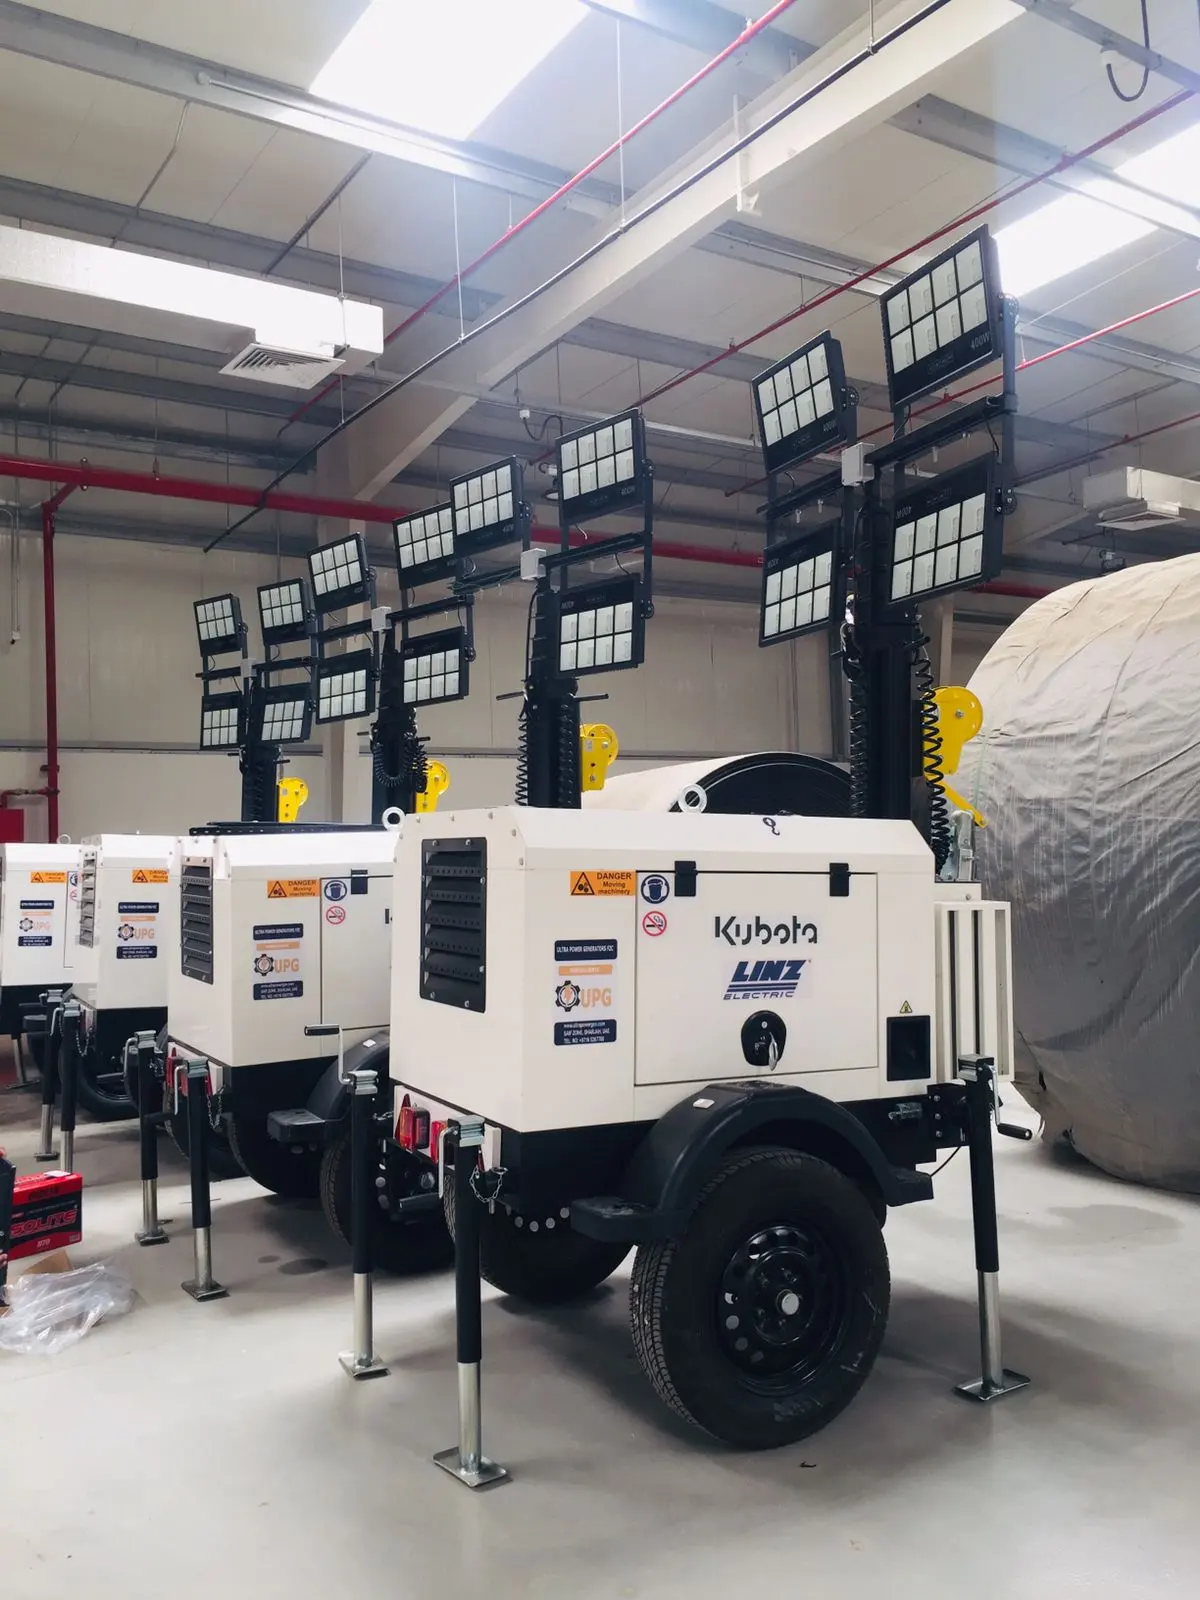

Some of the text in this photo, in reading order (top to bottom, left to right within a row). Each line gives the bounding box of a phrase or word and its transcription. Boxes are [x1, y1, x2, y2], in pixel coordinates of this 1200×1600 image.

[970, 331, 991, 350] 400W
[596, 872, 632, 880] DANGER
[602, 881, 626, 889] Moving
[134, 927, 156, 939] UPG
[714, 915, 818, 946] Kubota
[274, 958, 300, 973] UPG
[731, 960, 807, 983] LINZ
[580, 987, 612, 1008] UPG
[723, 991, 795, 1001] ELECTRIC
[9, 1208, 78, 1238] SOLITE
